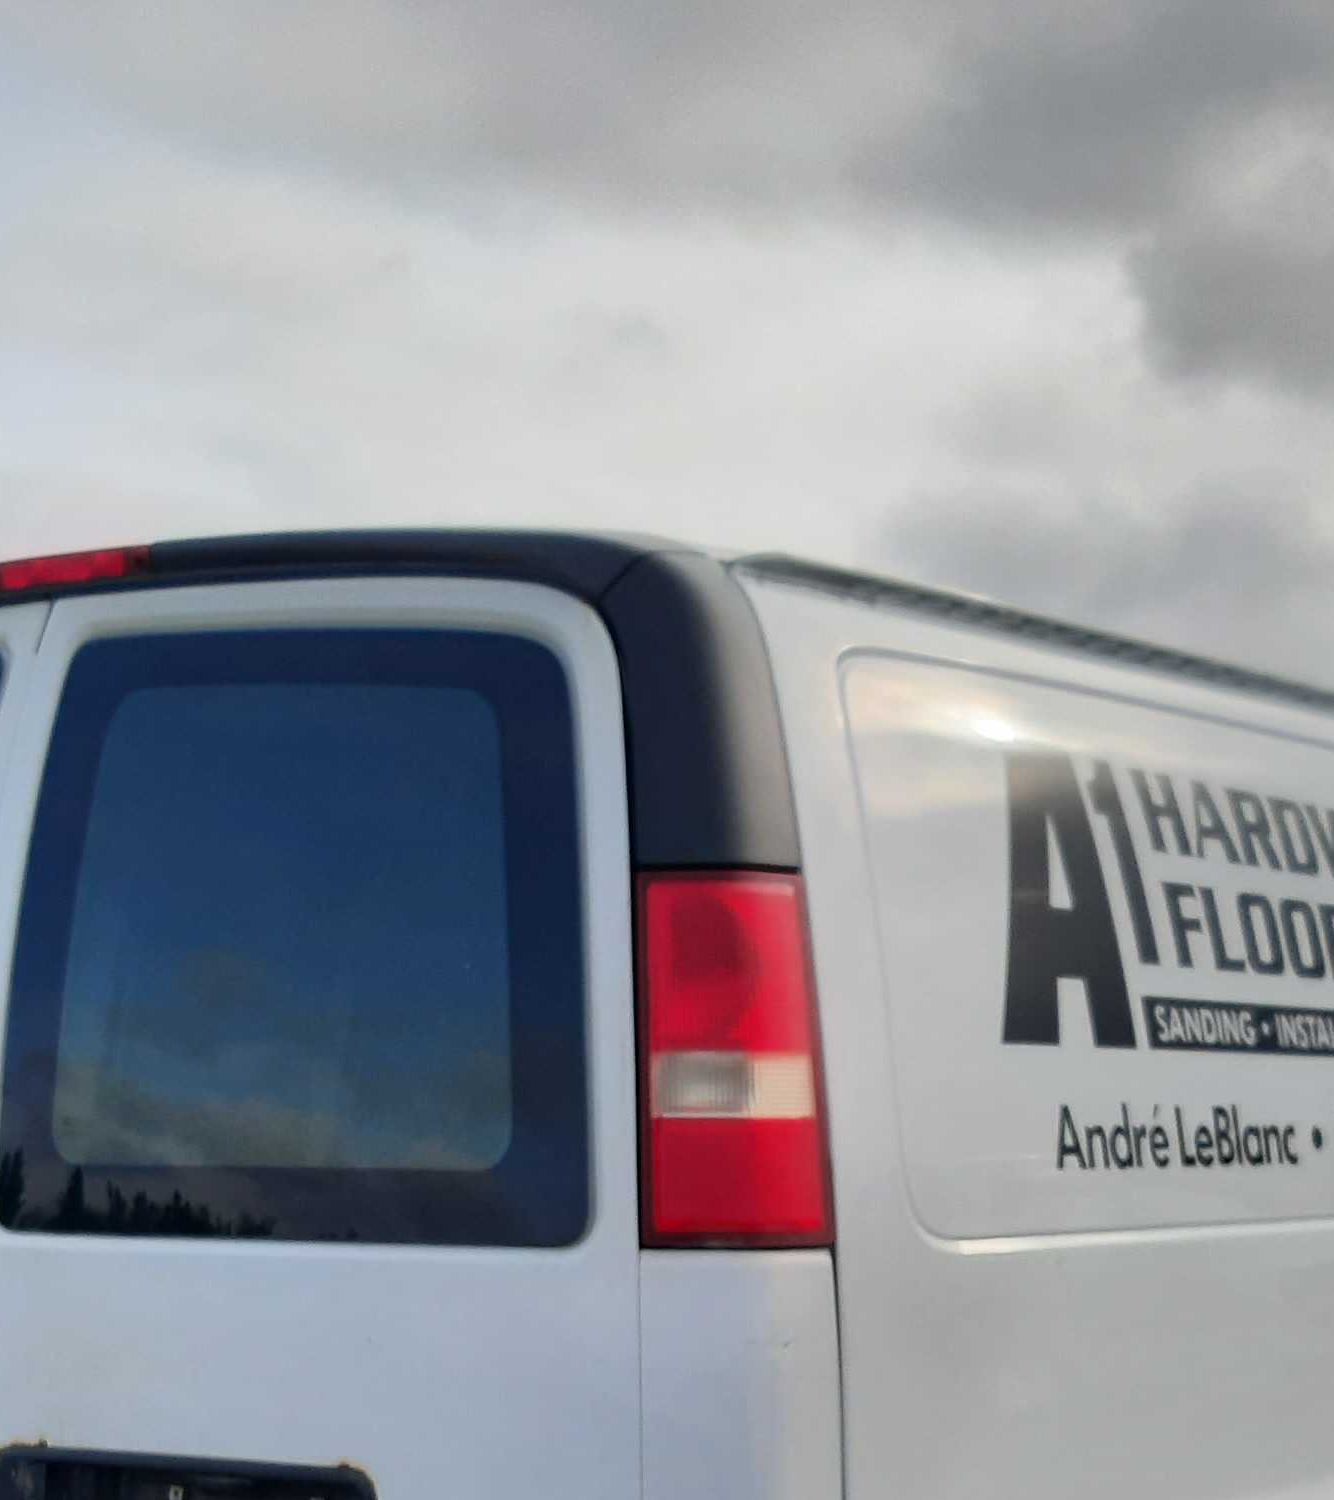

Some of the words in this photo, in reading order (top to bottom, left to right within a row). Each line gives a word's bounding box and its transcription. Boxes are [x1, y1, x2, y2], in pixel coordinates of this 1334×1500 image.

[1002, 752, 1160, 1048] A1
[1154, 1006, 1256, 1046] SANDING
[1056, 1103, 1170, 1170] André
[1174, 1104, 1299, 1168] LeBlanc
